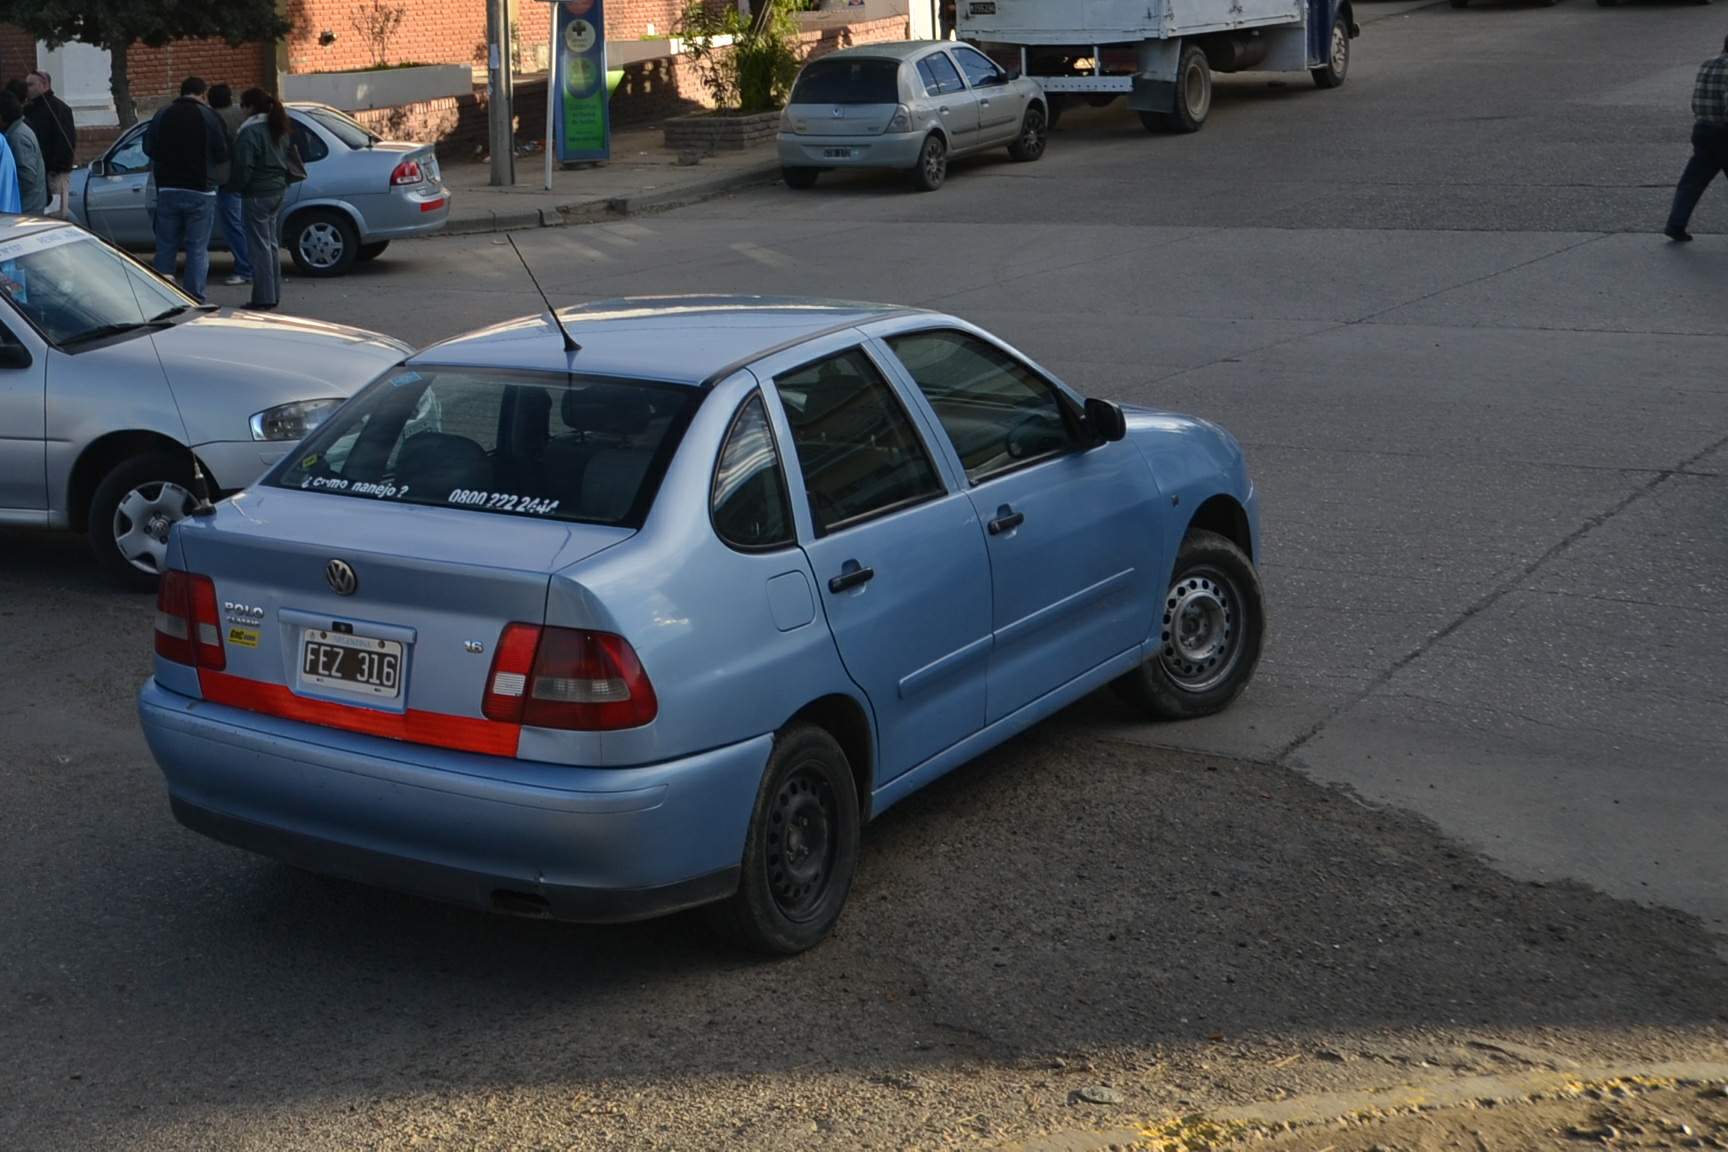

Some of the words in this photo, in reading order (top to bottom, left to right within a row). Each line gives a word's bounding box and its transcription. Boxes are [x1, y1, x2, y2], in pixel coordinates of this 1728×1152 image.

[448, 489, 488, 505] 0800
[486, 493, 518, 510] 222
[224, 601, 264, 618] POLO
[306, 644, 344, 677] FEZ
[356, 652, 396, 686] 316
